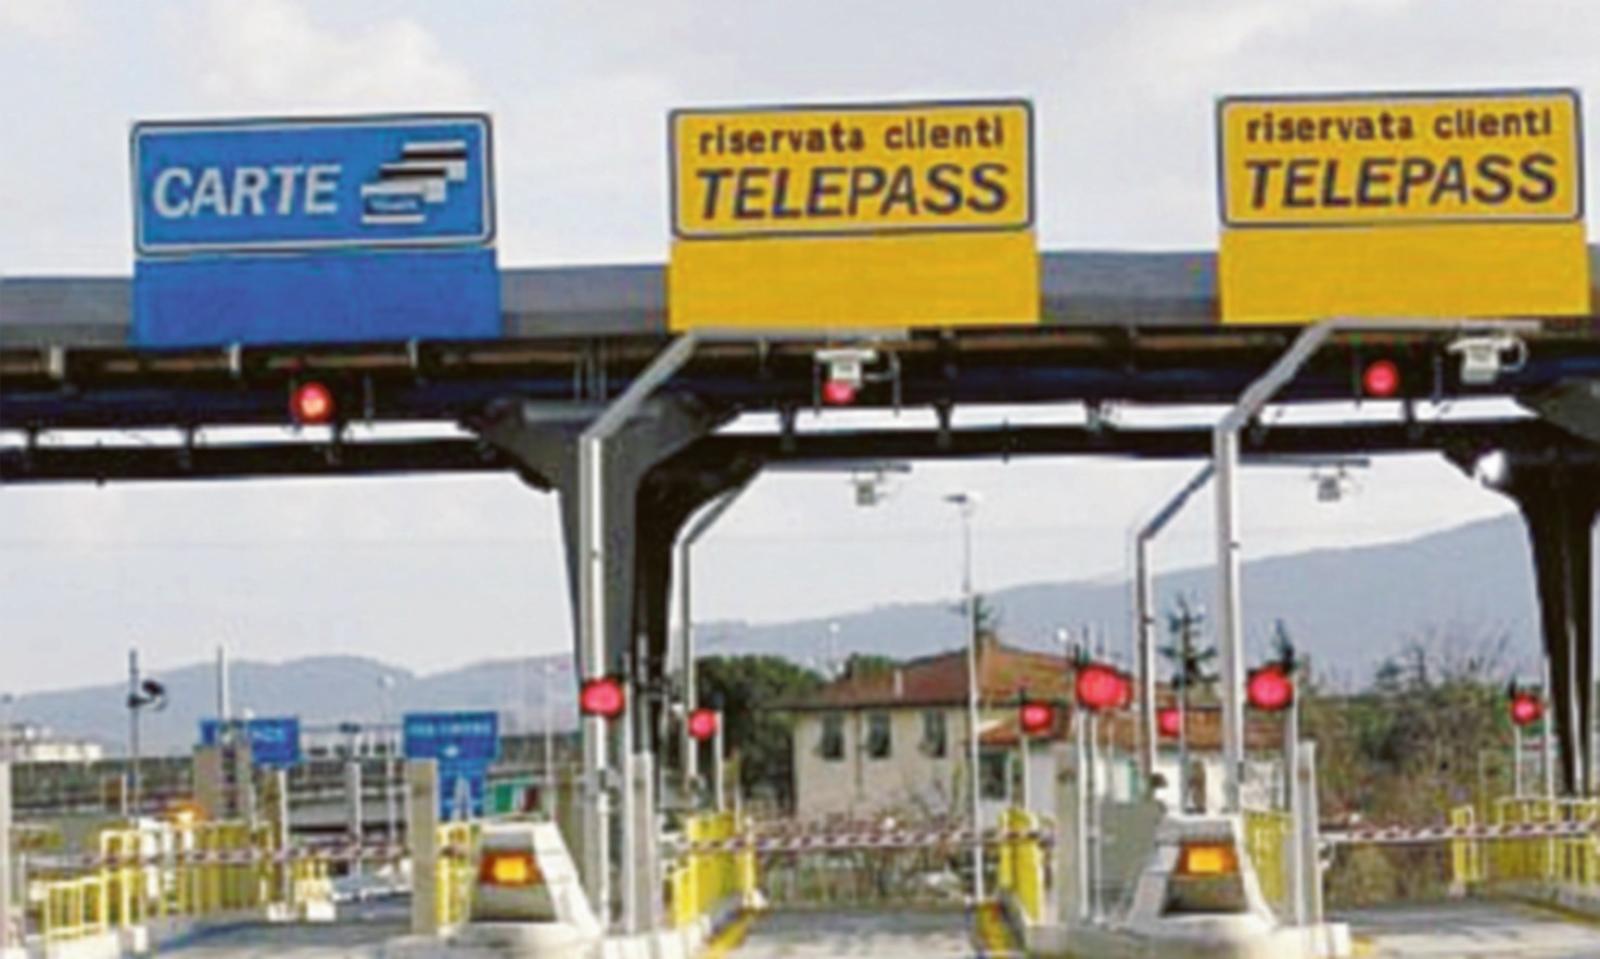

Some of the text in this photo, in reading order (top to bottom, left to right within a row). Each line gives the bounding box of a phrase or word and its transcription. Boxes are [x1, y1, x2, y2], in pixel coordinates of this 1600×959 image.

[698, 116, 1004, 156] riservata clienti
[1246, 108, 1552, 143] riservata clienti
[153, 163, 342, 219] CARTE
[696, 162, 1008, 220] TELEPASS
[1244, 153, 1557, 209] TELEPASS
